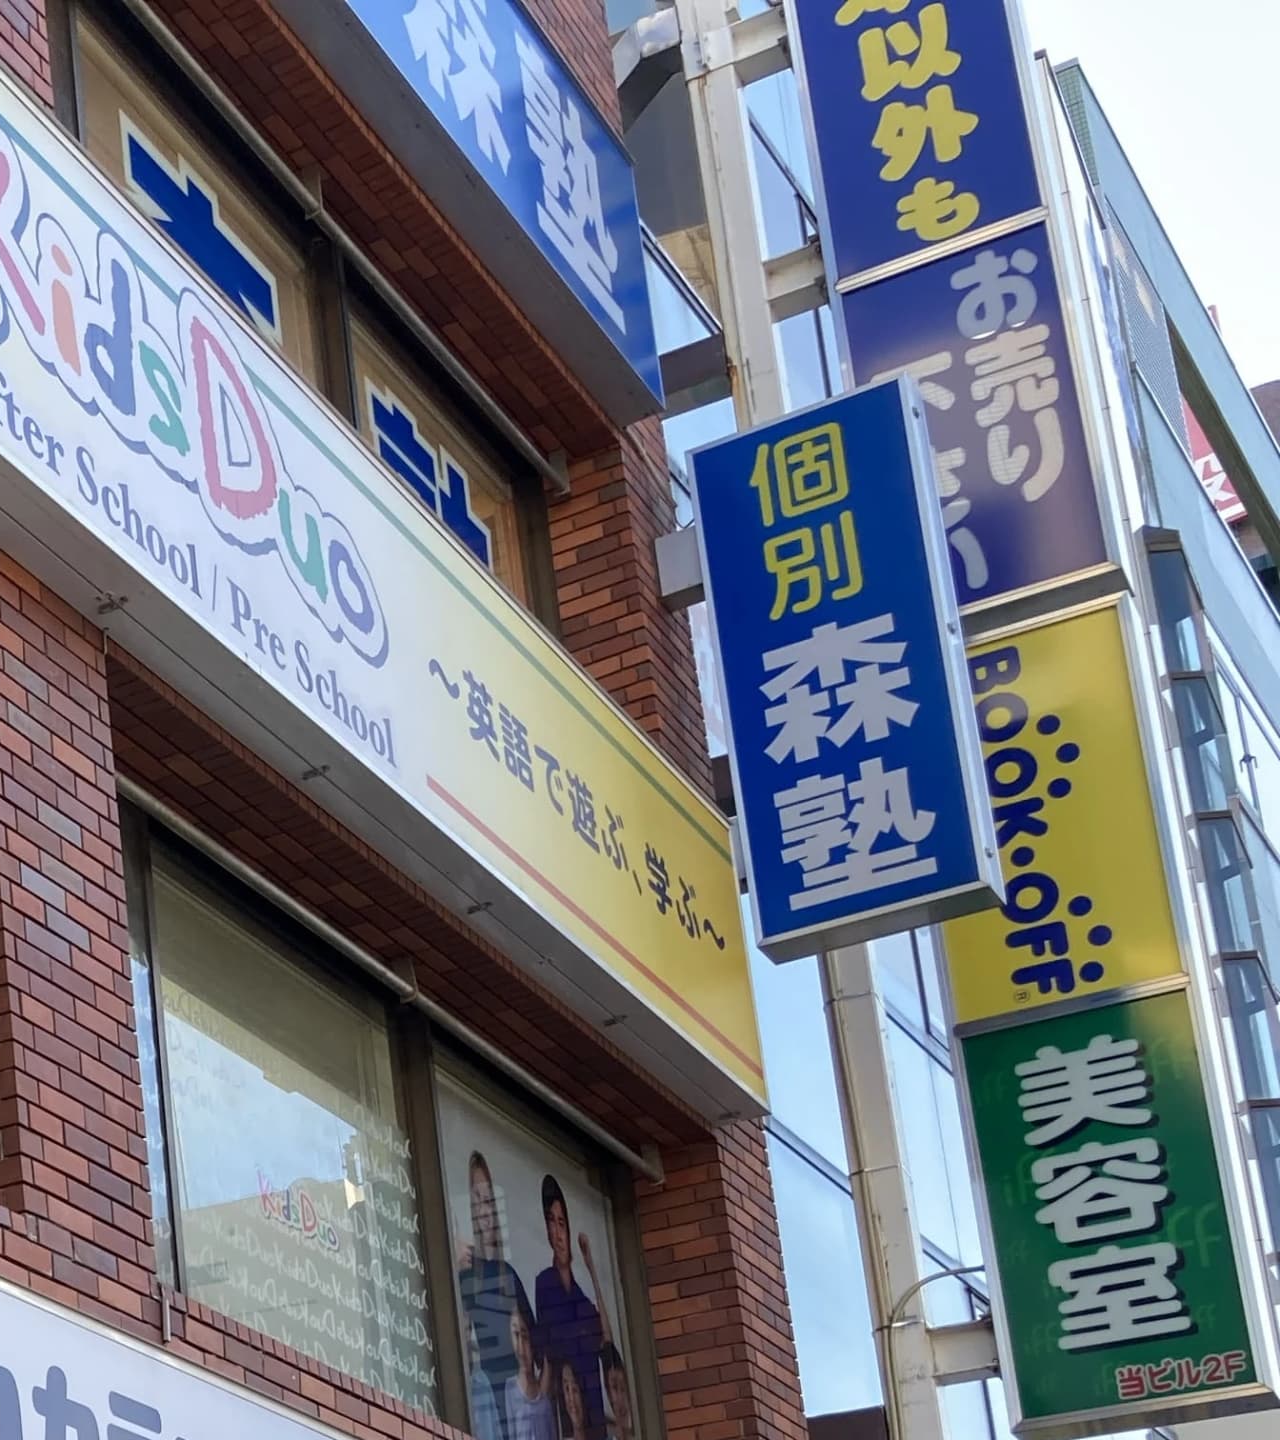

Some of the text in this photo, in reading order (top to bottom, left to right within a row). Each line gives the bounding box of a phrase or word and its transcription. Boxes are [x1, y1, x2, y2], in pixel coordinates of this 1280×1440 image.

[835, 0, 981, 242] 以外も
[75, 443, 204, 600] School
[227, 574, 289, 673] Pre
[294, 637, 397, 768] School
[1013, 1033, 1193, 1352] 美容室
[1116, 1349, 1247, 1400] 当ビル2F
